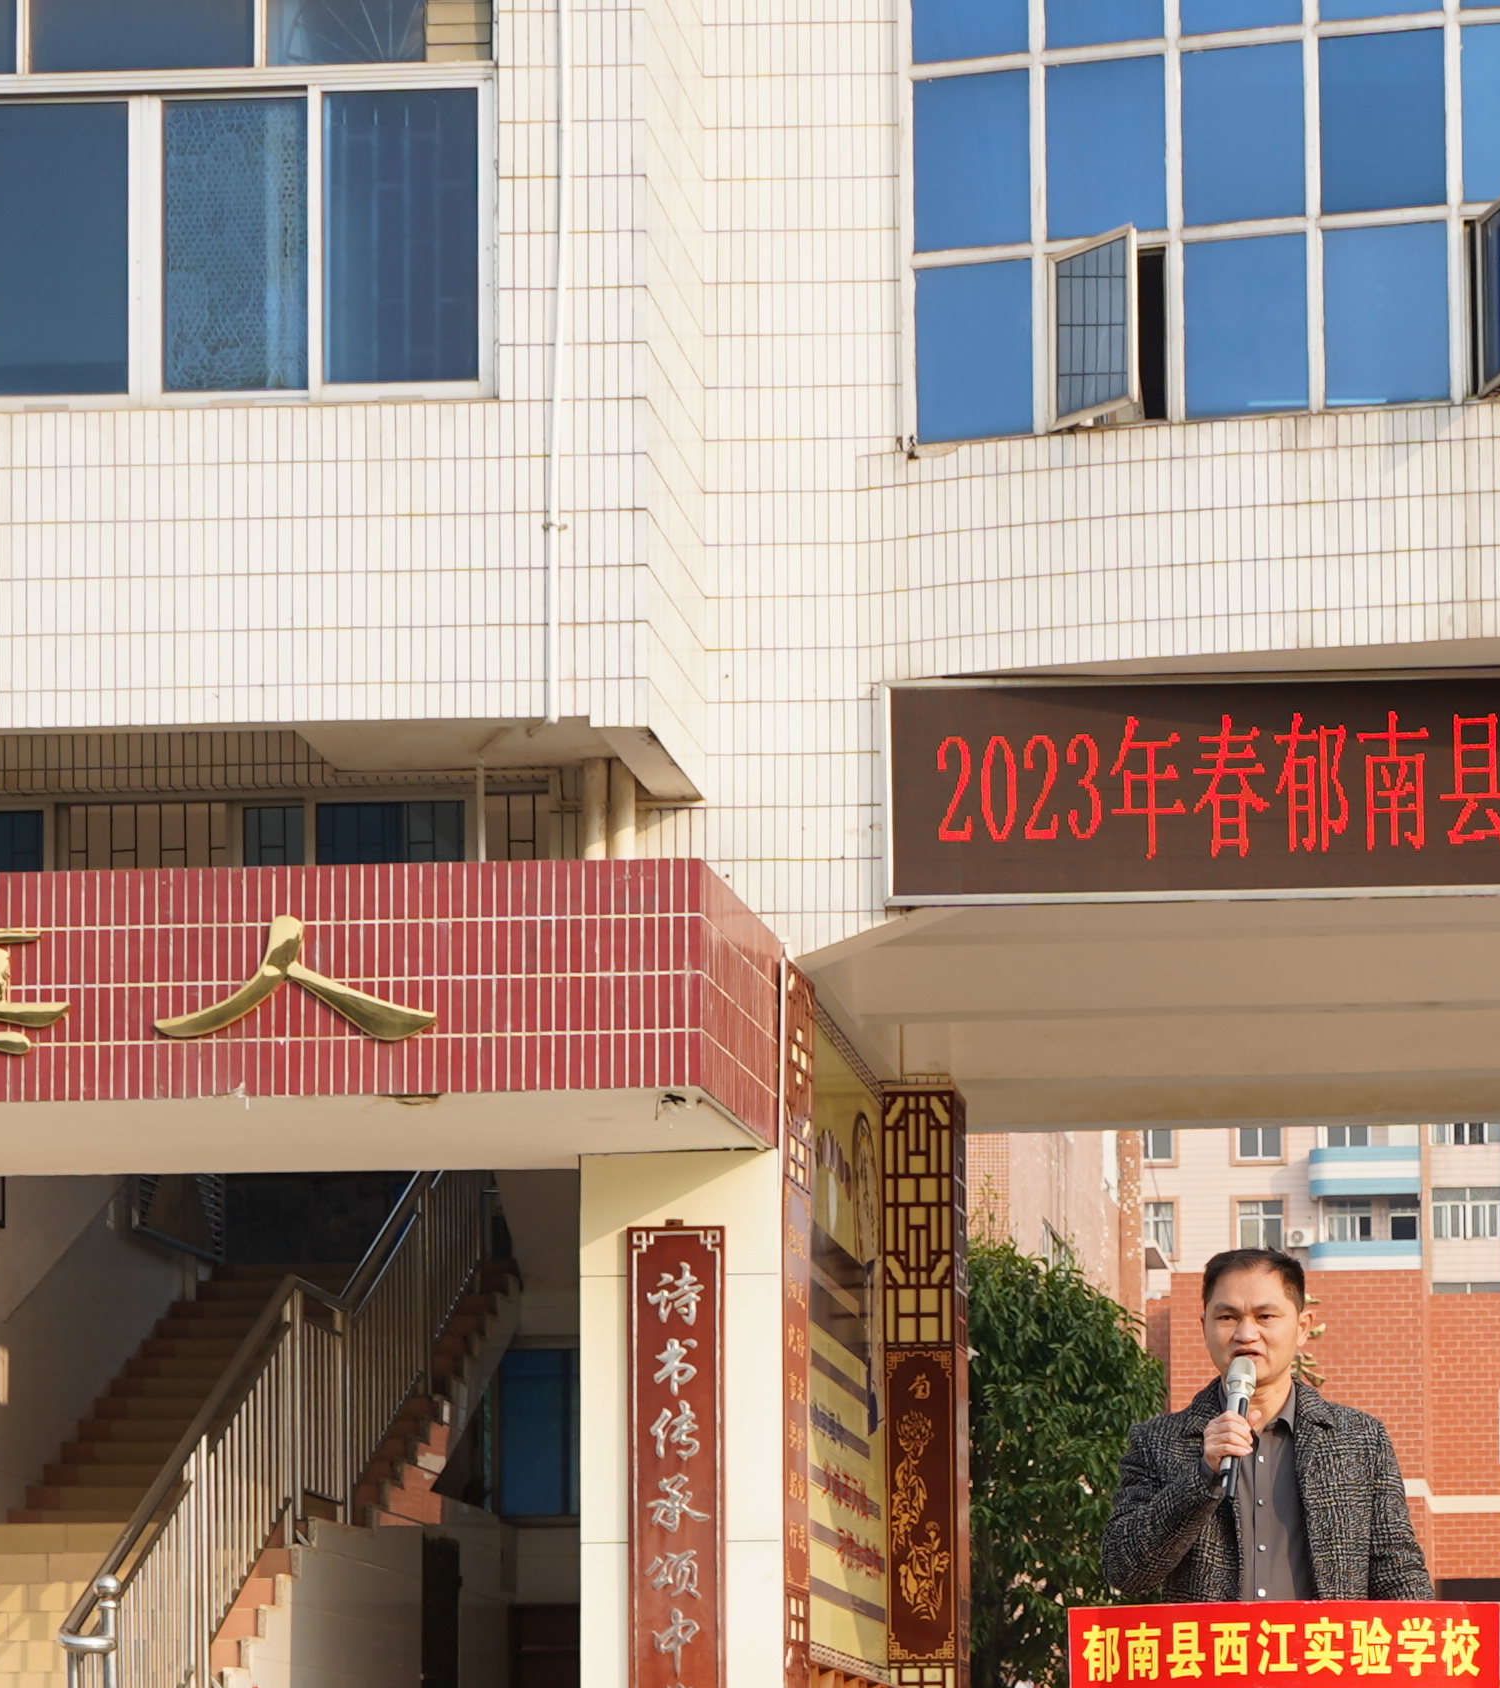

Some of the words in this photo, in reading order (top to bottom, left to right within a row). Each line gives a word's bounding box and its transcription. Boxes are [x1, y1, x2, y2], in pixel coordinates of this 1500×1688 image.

[1082, 1616, 1481, 1682] 郁南县西江实验学校
